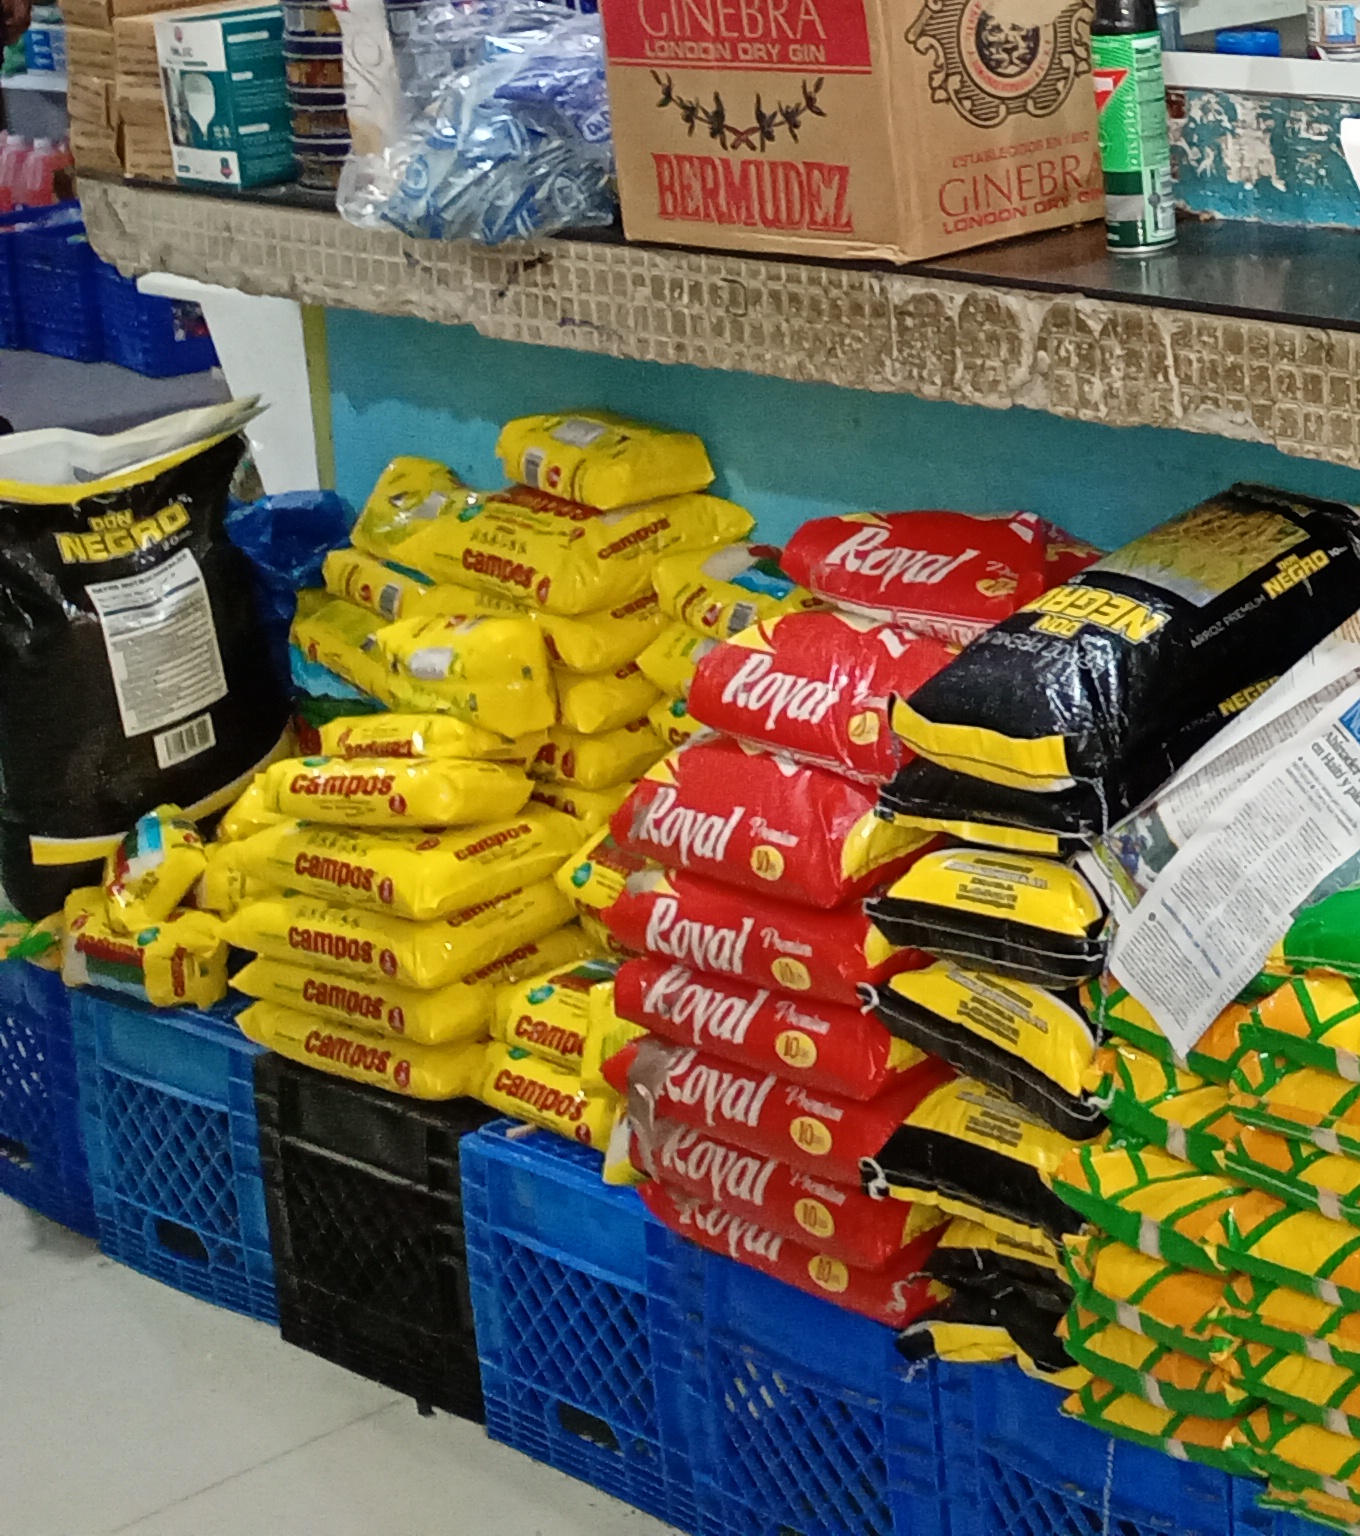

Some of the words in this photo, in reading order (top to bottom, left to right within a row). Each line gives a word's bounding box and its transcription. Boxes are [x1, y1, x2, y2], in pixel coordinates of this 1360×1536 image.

[644, 40, 732, 61] LONDON
[740, 41, 781, 62] DRY
[789, 43, 826, 63] GIN
[652, 152, 854, 234] BERMUDEZ
[943, 204, 1028, 235] LONDON
[1034, 192, 1070, 214] DRY
[55, 503, 191, 563] NEGRO
[90, 510, 134, 533] DON
[462, 549, 534, 587] campos
[825, 526, 979, 586] Royal
[1261, 549, 1330, 600] NEGRO
[289, 771, 395, 798] campos
[454, 823, 533, 862] campos
[640, 786, 747, 866] Royal
[295, 851, 374, 894] campos
[288, 924, 374, 965] campos
[645, 897, 755, 975] Royal
[302, 976, 384, 1022] campos
[643, 964, 771, 1045] Royal
[304, 1028, 391, 1076] campos
[493, 1069, 588, 1122] campos
[666, 1047, 778, 1127] Royal
[662, 1125, 778, 1206] Royal
